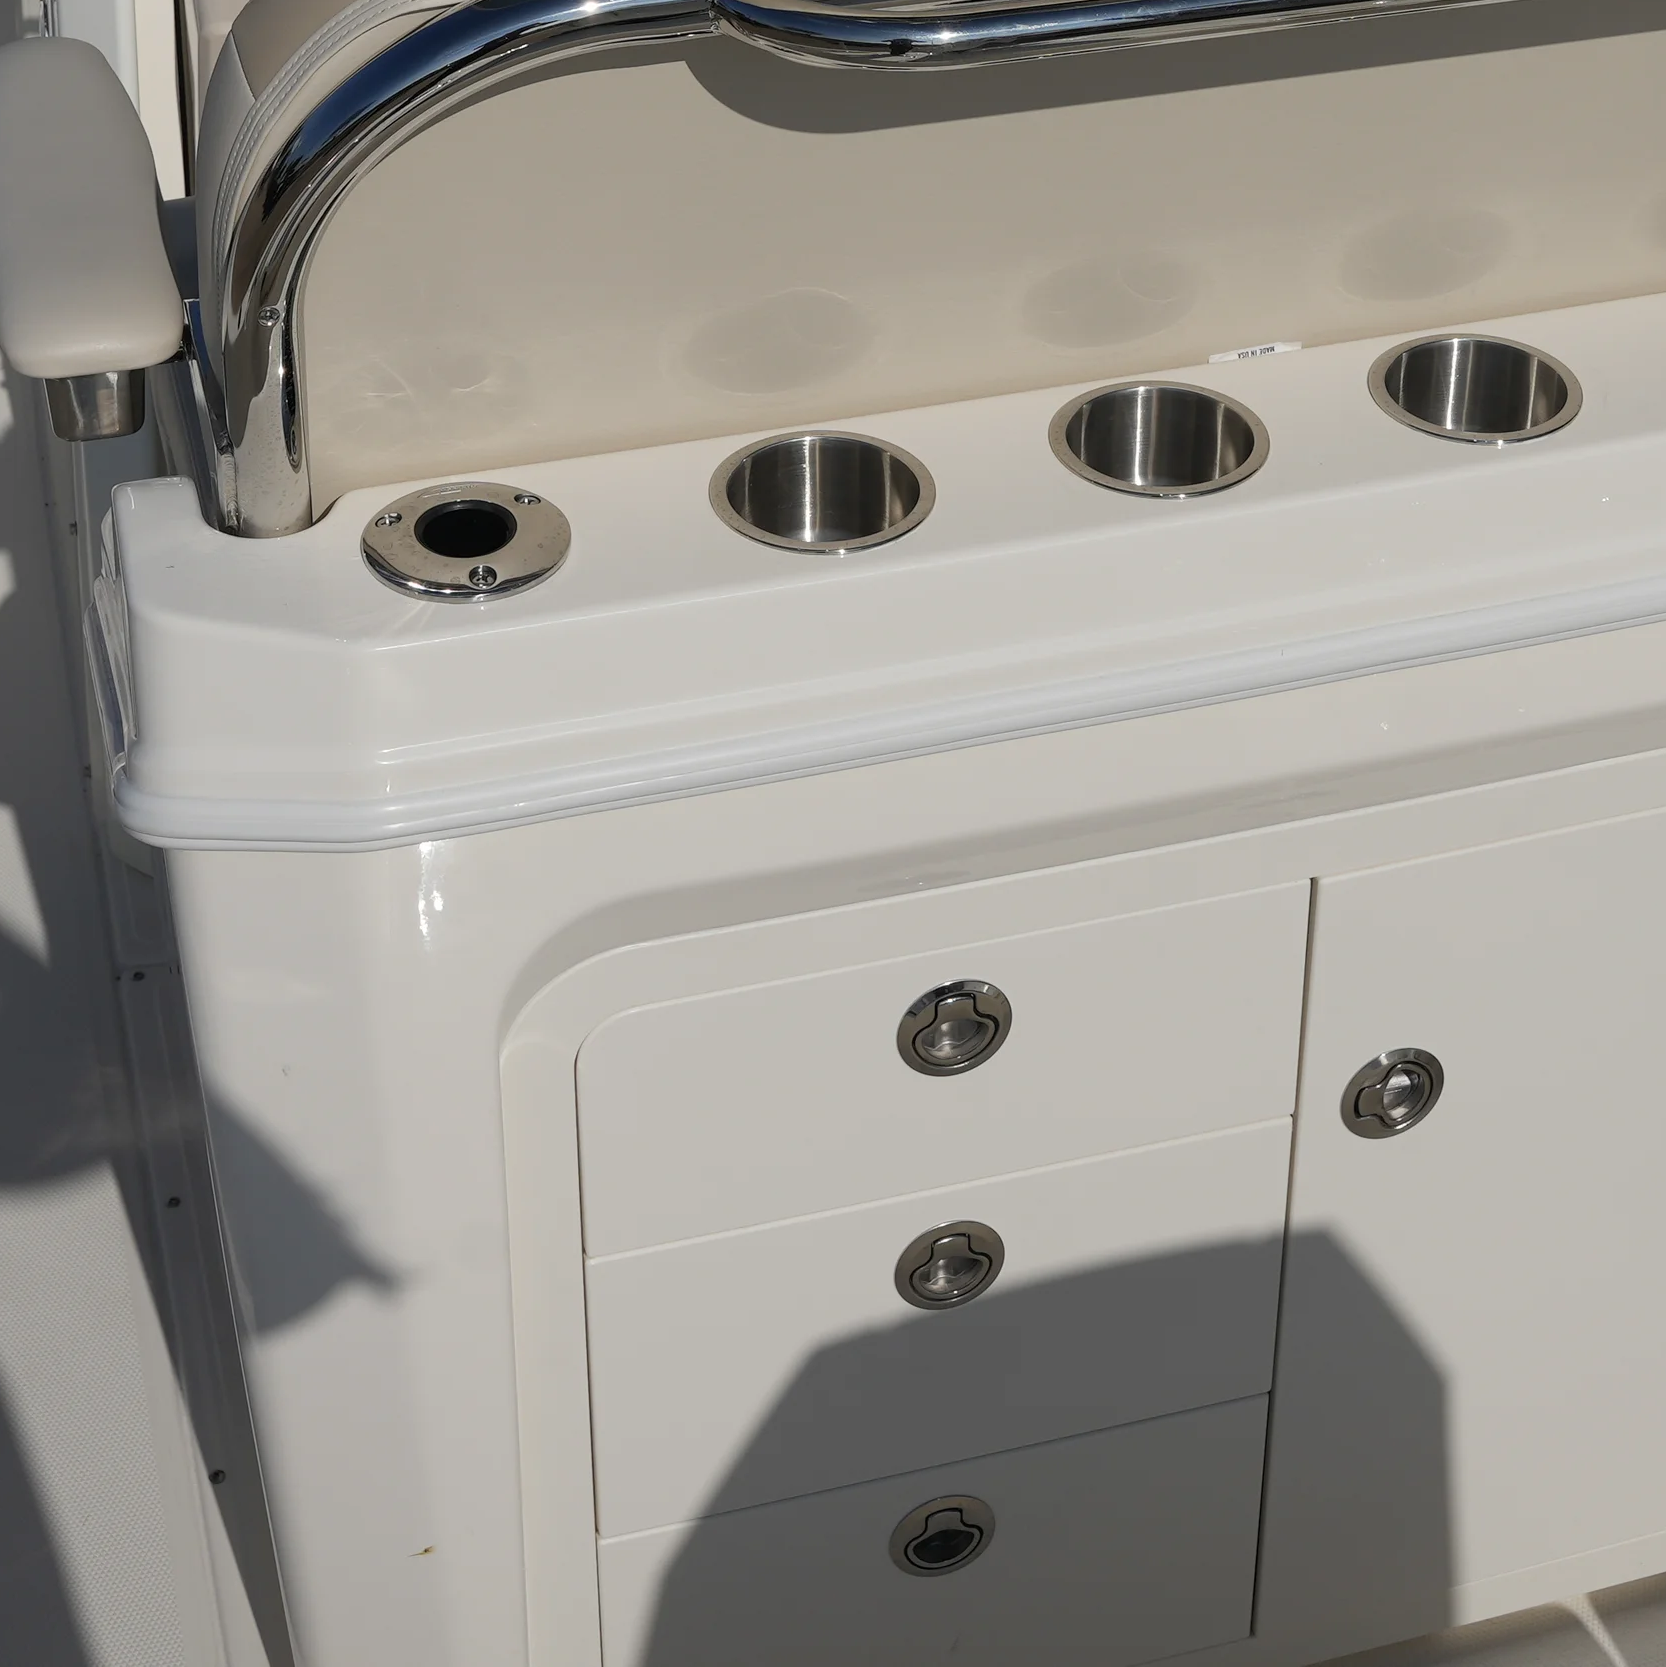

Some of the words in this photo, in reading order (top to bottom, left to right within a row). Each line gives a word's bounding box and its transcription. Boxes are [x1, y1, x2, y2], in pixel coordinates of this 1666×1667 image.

[1250, 349, 1258, 357] IN
[1259, 346, 1275, 355] MADE
[1237, 351, 1249, 359] USA
